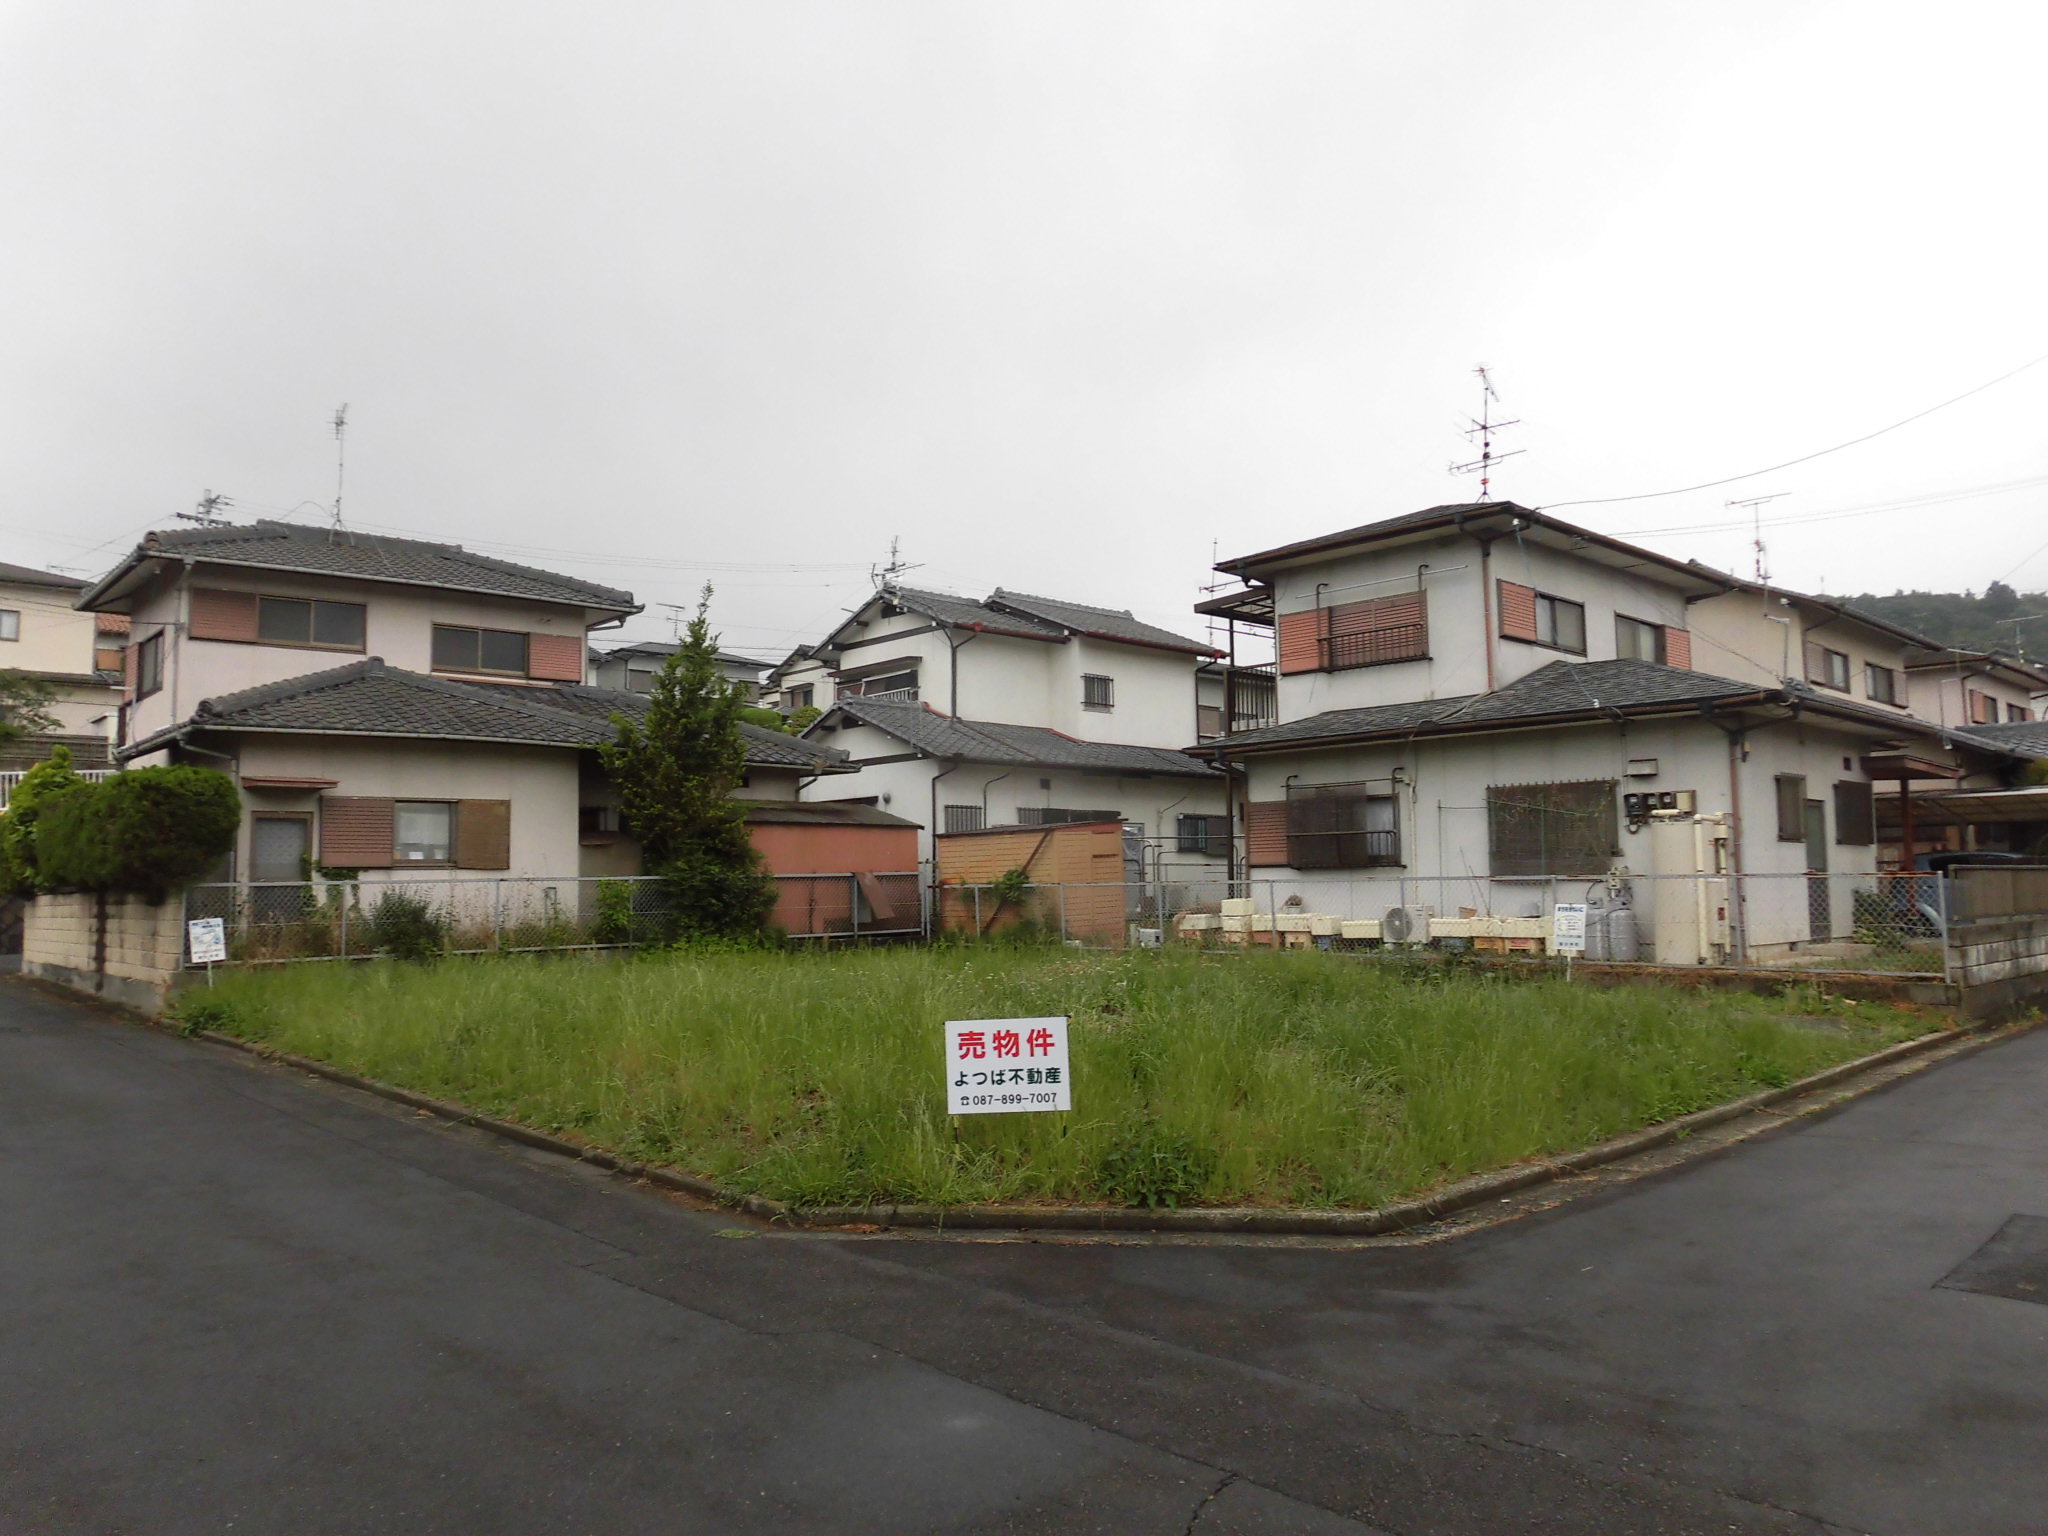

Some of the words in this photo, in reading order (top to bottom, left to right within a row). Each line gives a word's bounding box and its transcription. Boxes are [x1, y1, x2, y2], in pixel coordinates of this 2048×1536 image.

[957, 1027, 1055, 1060] 売物件
[954, 1067, 1062, 1087] よつば不動産
[972, 1092, 1057, 1106] 087-899-7007
